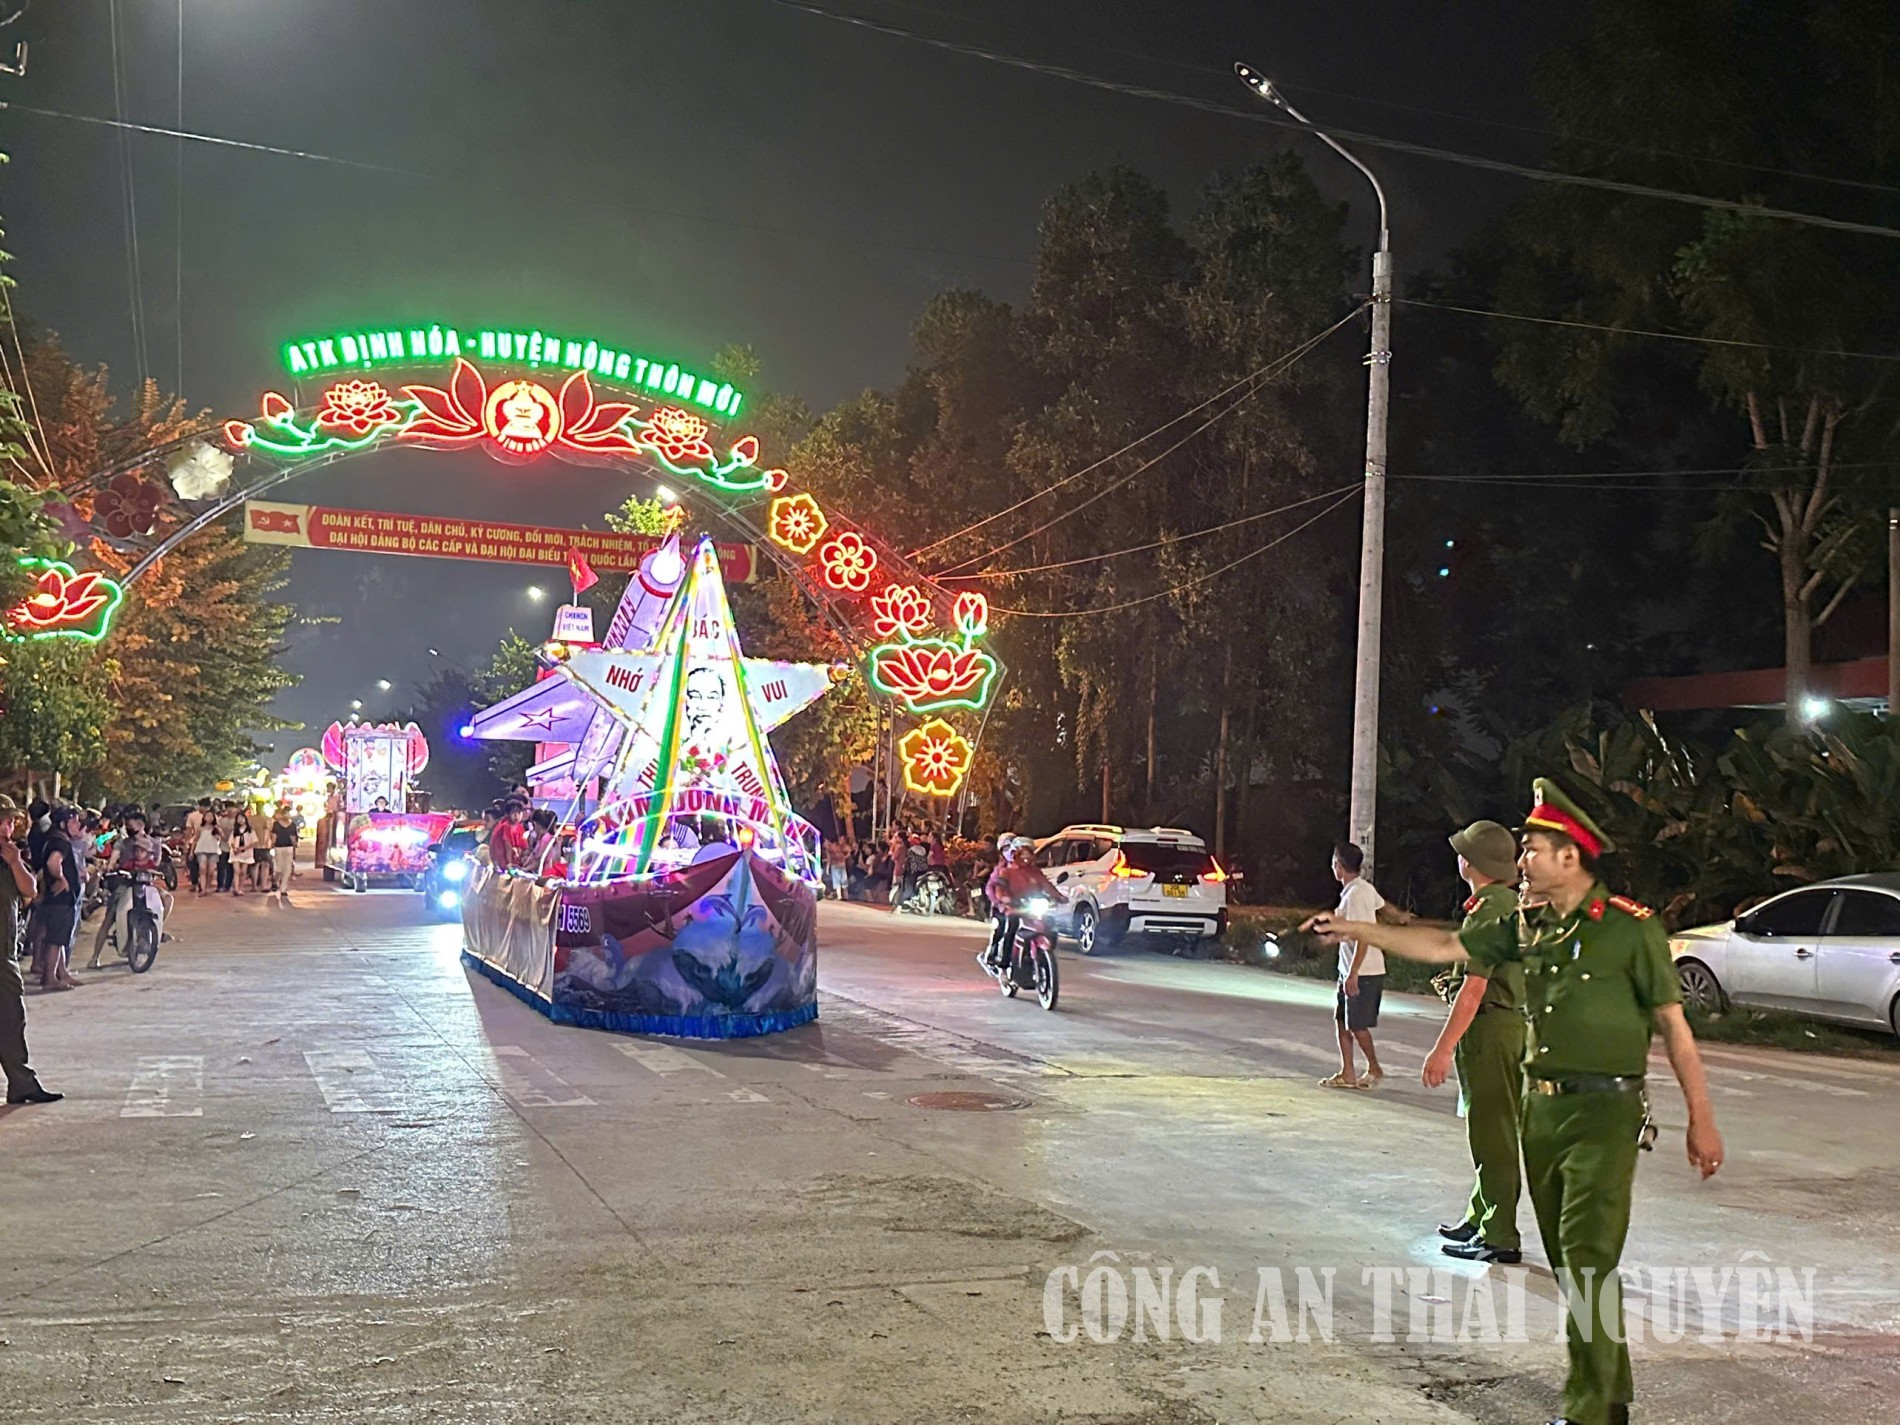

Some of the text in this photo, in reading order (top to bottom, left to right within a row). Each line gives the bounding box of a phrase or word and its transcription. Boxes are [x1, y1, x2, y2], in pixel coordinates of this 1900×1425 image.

[289, 338, 339, 374] ATK
[410, 324, 461, 357] HÓA
[480, 330, 561, 368] HUYỆN
[565, 340, 633, 379] NÔNG
[634, 357, 696, 400] THÔN
[695, 378, 743, 417] MỚI
[322, 512, 352, 528] ĐOÀN
[354, 514, 375, 531] KẾT,
[377, 516, 394, 532] TRÍ
[396, 519, 418, 535] TUỆ,
[420, 521, 442, 535] DÂN
[444, 522, 468, 538] CHỦ,
[568, 533, 600, 549] TRÁCH
[329, 531, 348, 546] ĐẠI
[350, 531, 369, 548] HỘI
[370, 532, 400, 548] ĐẢNG
[401, 537, 416, 552] BỘ
[418, 538, 440, 552] CÁC
[441, 537, 462, 553] CẤP
[465, 541, 478, 555] VÀ
[480, 544, 497, 558] ĐẠI
[500, 544, 517, 560] HỘI
[519, 546, 536, 561] ĐẠI
[606, 665, 644, 693] NHỚ
[761, 679, 789, 703] VUI
[567, 905, 591, 933] 5569
